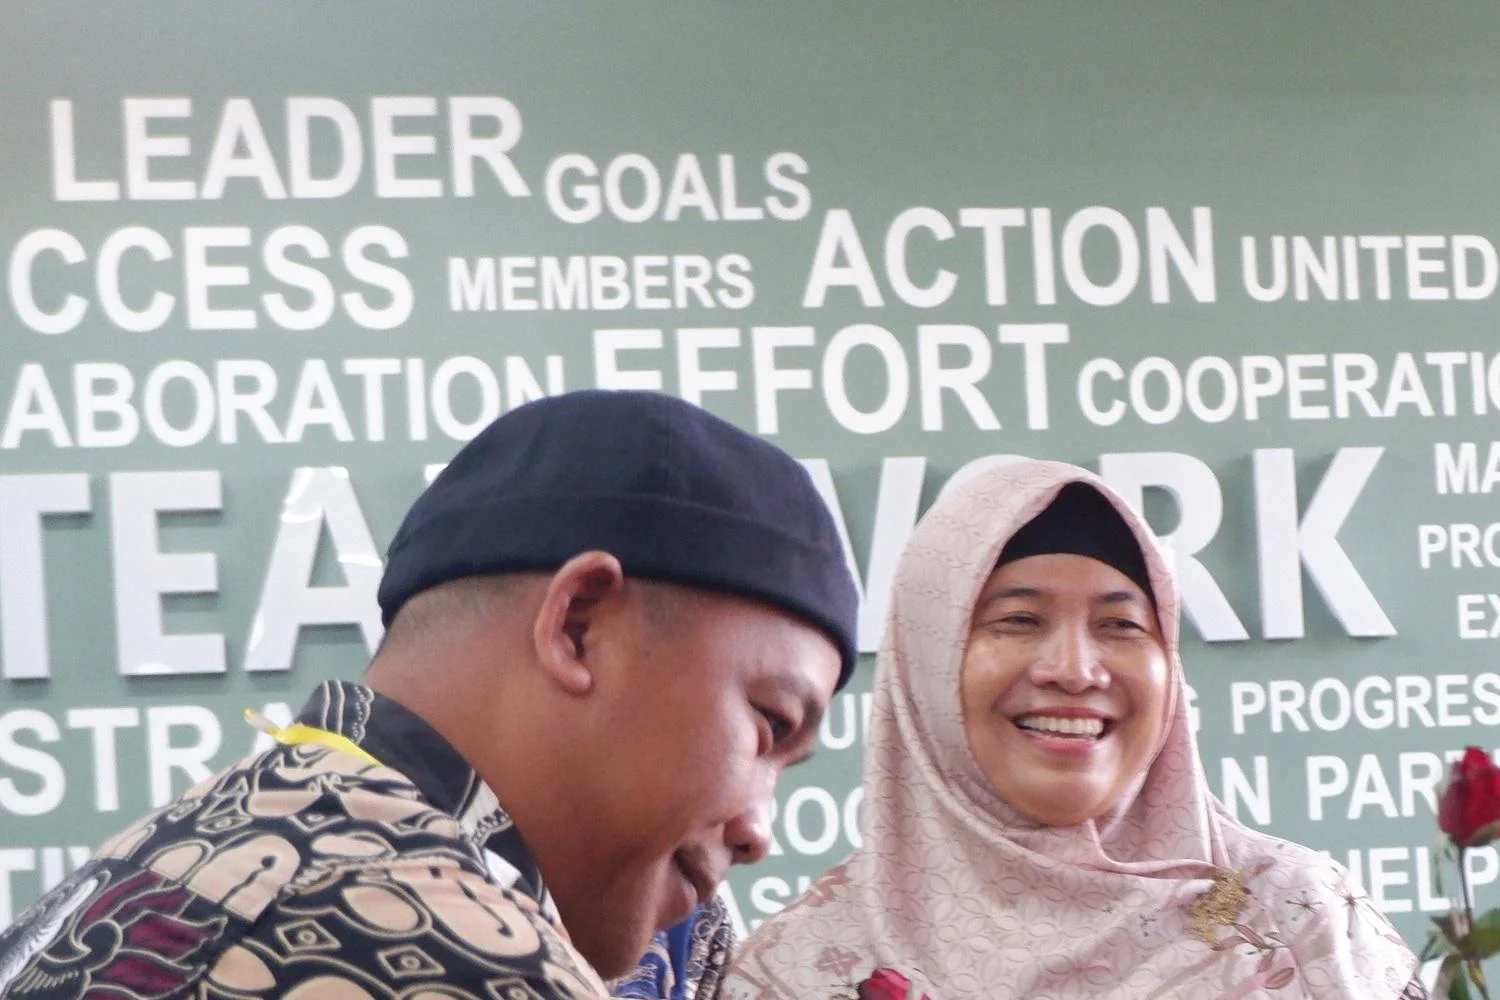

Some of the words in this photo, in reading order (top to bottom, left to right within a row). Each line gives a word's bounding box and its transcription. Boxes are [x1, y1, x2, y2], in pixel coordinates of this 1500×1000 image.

[50, 97, 530, 201] LEADER
[544, 152, 811, 223] GOALS
[9, 225, 414, 334] CCESS
[448, 253, 754, 311] MEMBERS
[802, 203, 1216, 308] ACTION
[1241, 235, 1499, 302] UNITED
[1322, 847, 1500, 913] ELP
